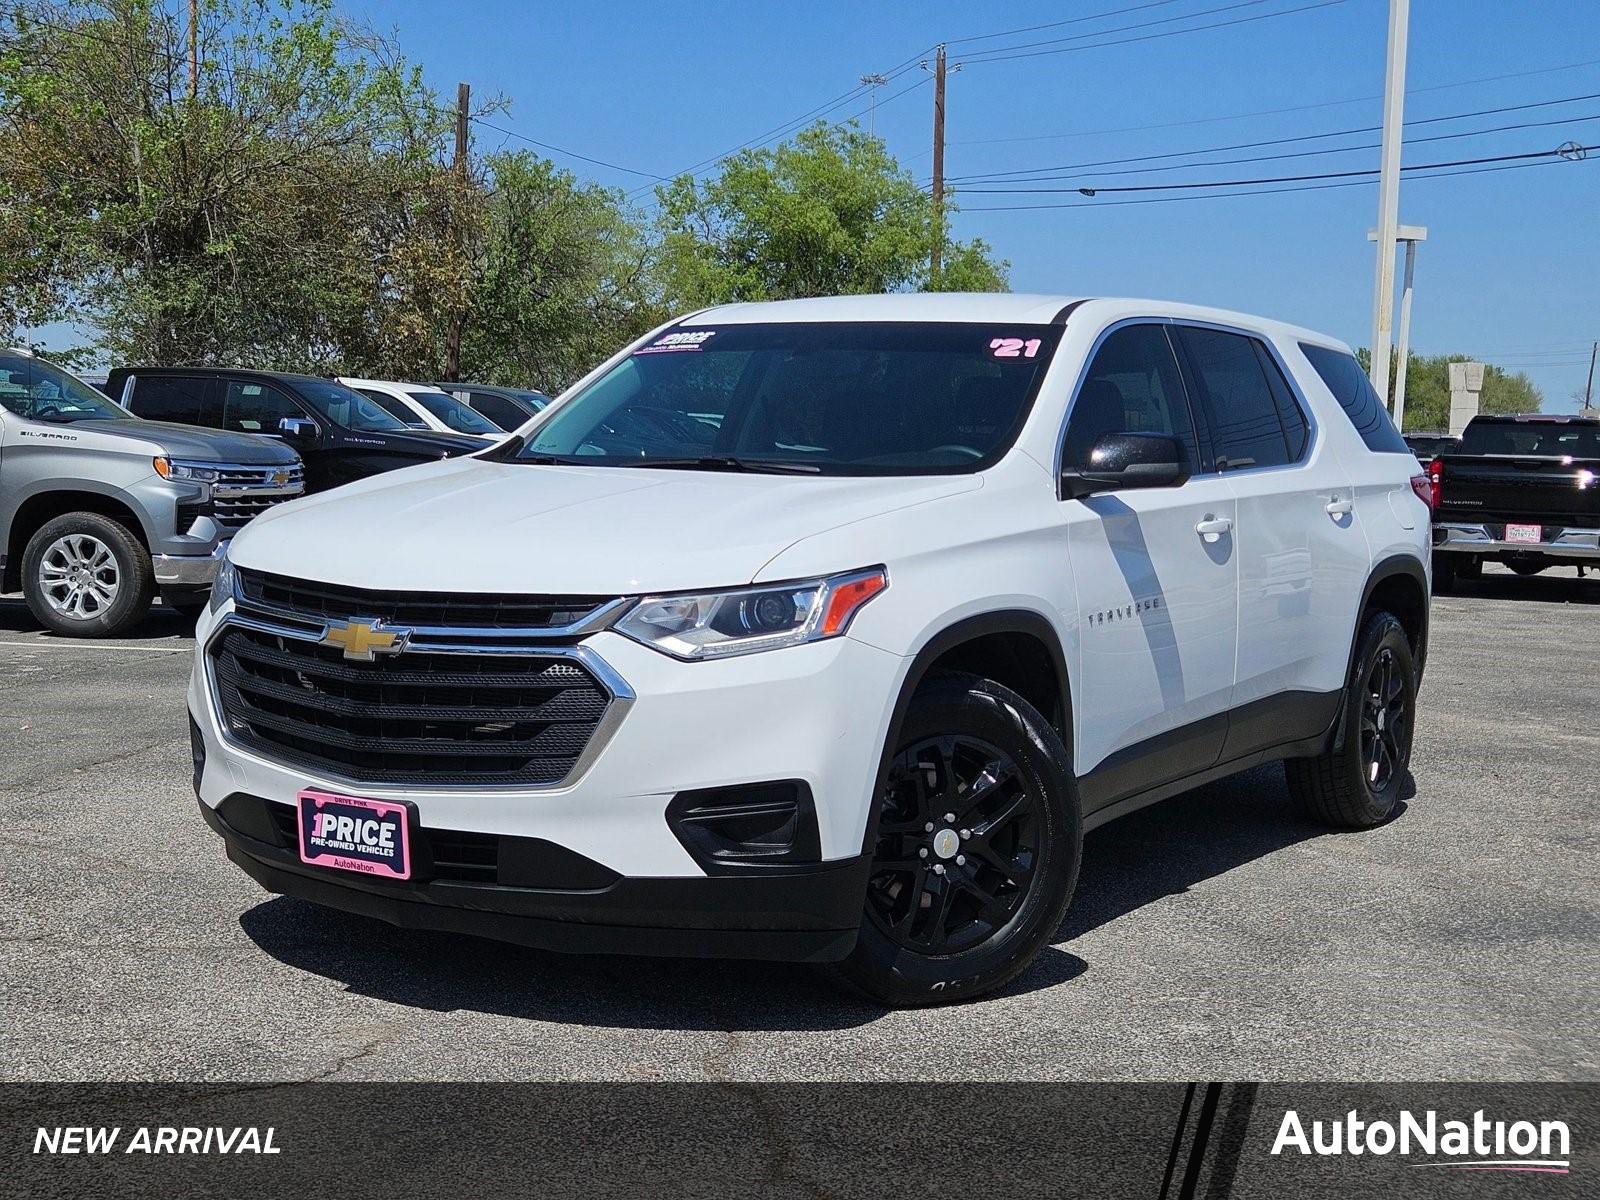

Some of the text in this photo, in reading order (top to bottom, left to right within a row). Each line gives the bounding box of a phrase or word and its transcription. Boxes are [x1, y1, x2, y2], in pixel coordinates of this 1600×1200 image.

[20, 431, 78, 441] SILVERADO
[1088, 598, 1159, 628] TRAVERSE
[334, 797, 352, 805] DRIVE
[311, 812, 396, 849] 1PRICE
[310, 837, 395, 857] PRE-OWNED VEHICLES
[334, 858, 375, 872] AutoNation
